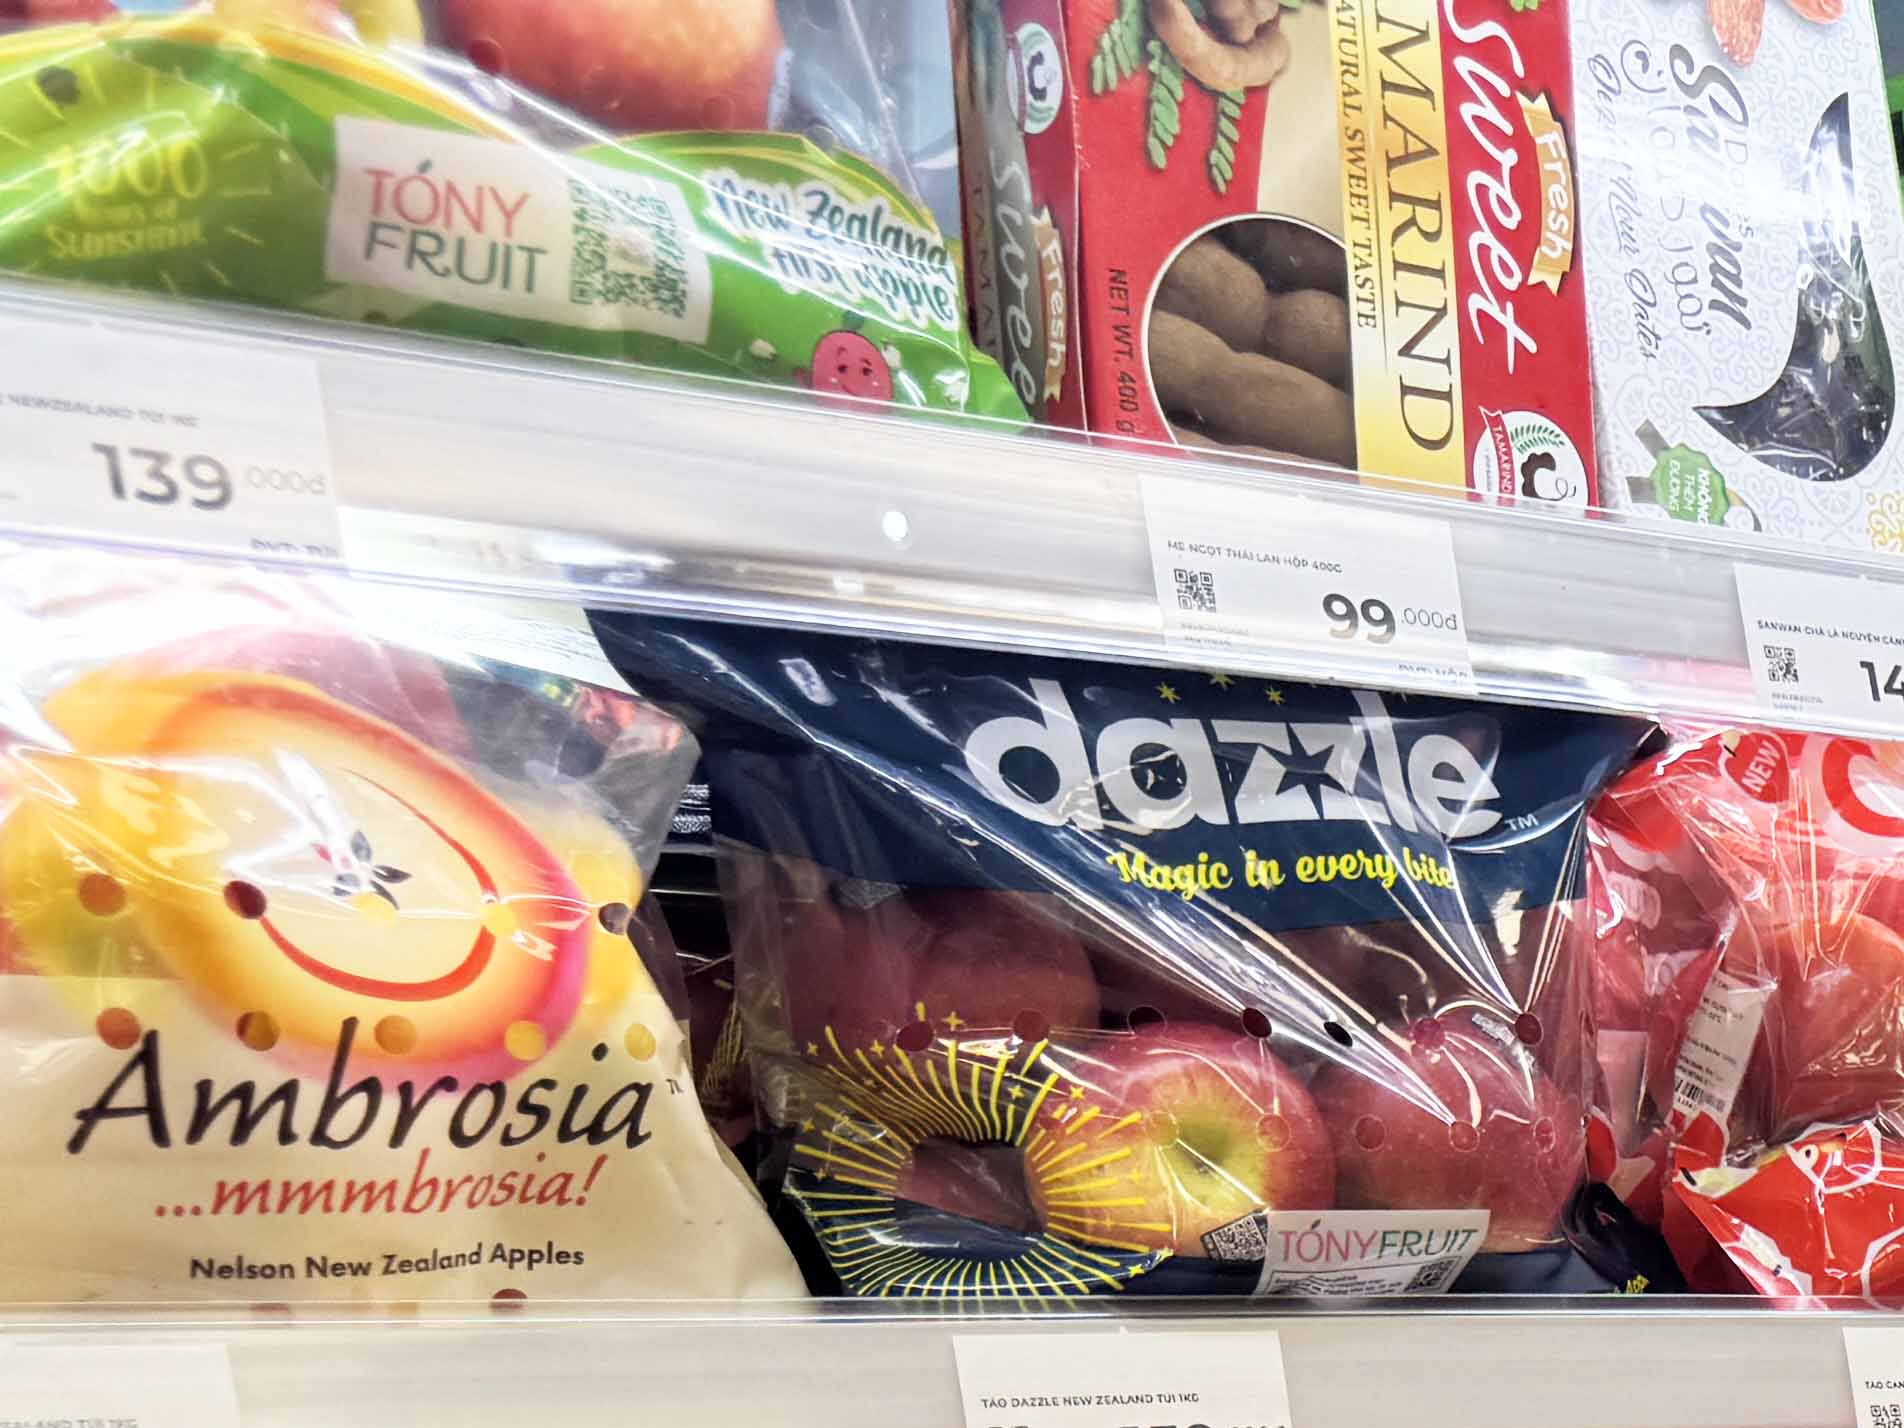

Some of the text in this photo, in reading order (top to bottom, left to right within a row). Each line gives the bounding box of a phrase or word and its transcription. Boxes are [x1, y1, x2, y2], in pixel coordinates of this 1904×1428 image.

[363, 160, 530, 238] TÓNY
[1448, 0, 1538, 376] Sweet
[1533, 130, 1570, 260] Fresh
[362, 222, 548, 296] FRUIT
[1344, 125, 1378, 331] SWEET TASTE
[1107, 267, 1139, 413] NET 400
[92, 442, 233, 511] 139
[1322, 592, 1397, 645] 99
[964, 678, 1503, 838] dazzle
[1741, 742, 1780, 796] NEW
[1107, 845, 1454, 900] Magic in every bite
[66, 1016, 655, 1157] Ambrosia
[190, 1240, 587, 1284] Nelson New Zealand Apples
[1011, 1393, 1154, 1409] DAZZLE NEW ZEALAND
